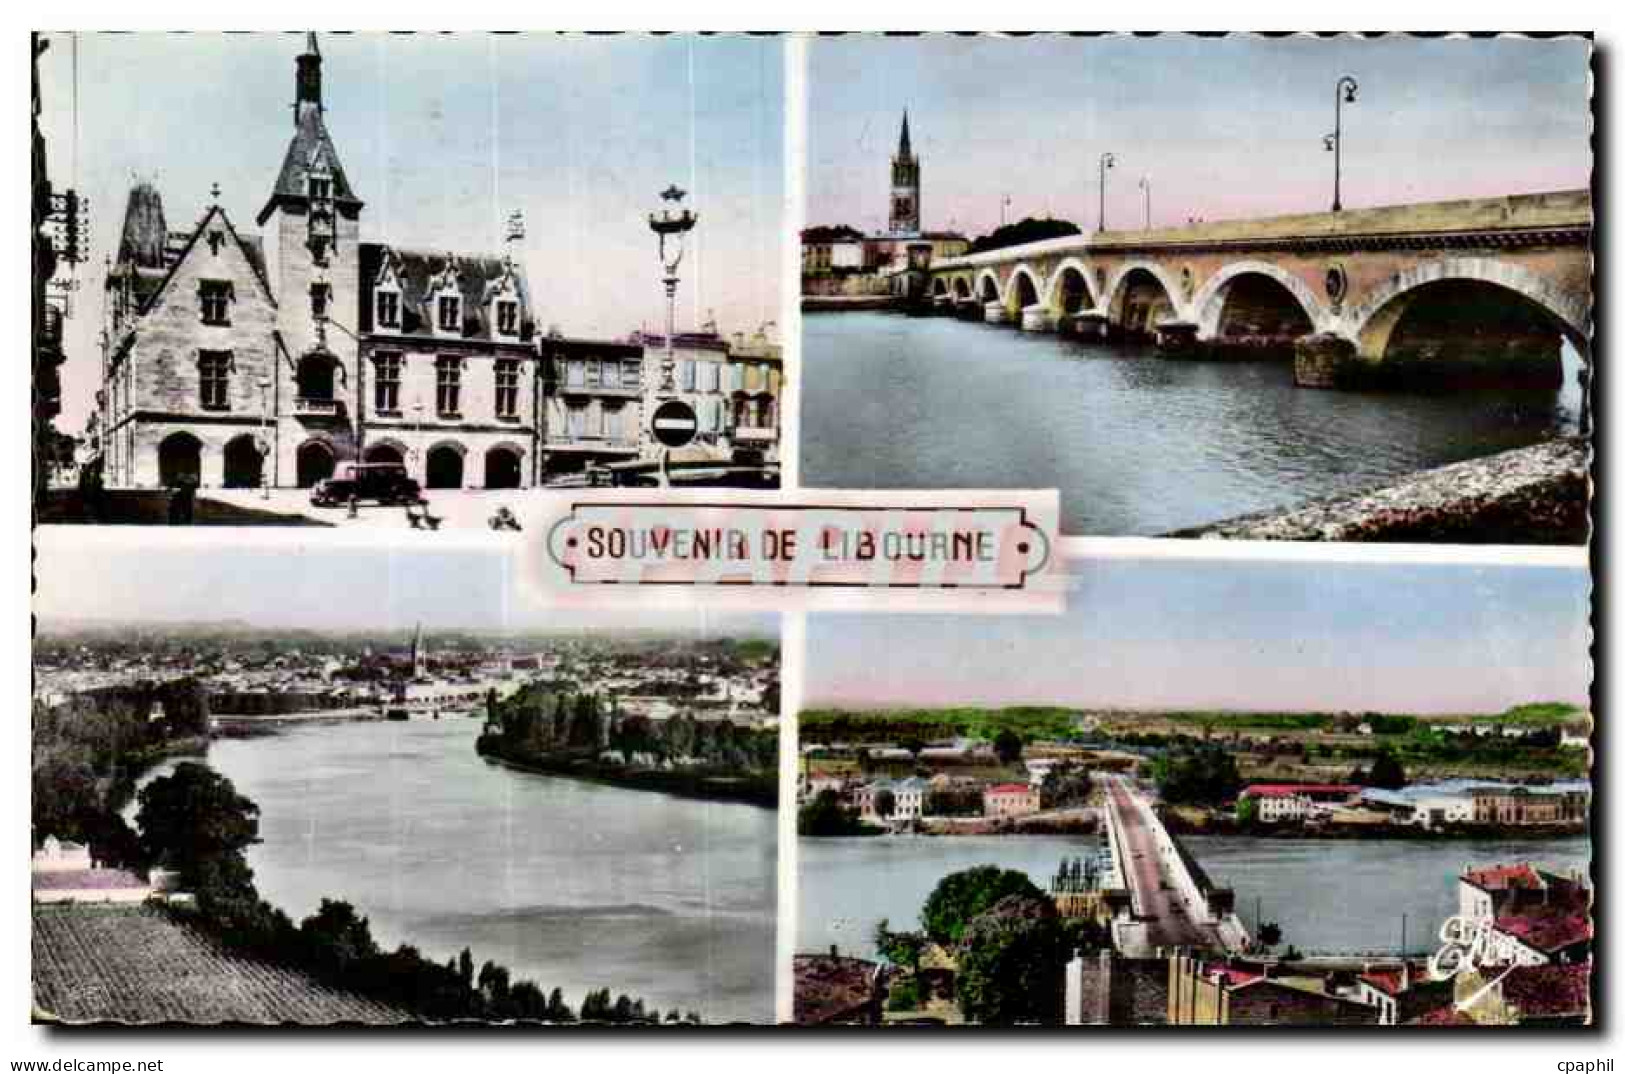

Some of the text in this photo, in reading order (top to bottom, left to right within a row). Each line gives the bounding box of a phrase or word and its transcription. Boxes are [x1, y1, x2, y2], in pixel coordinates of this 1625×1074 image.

[587, 527, 995, 562] SOUVENIR DE LIBOURNE
